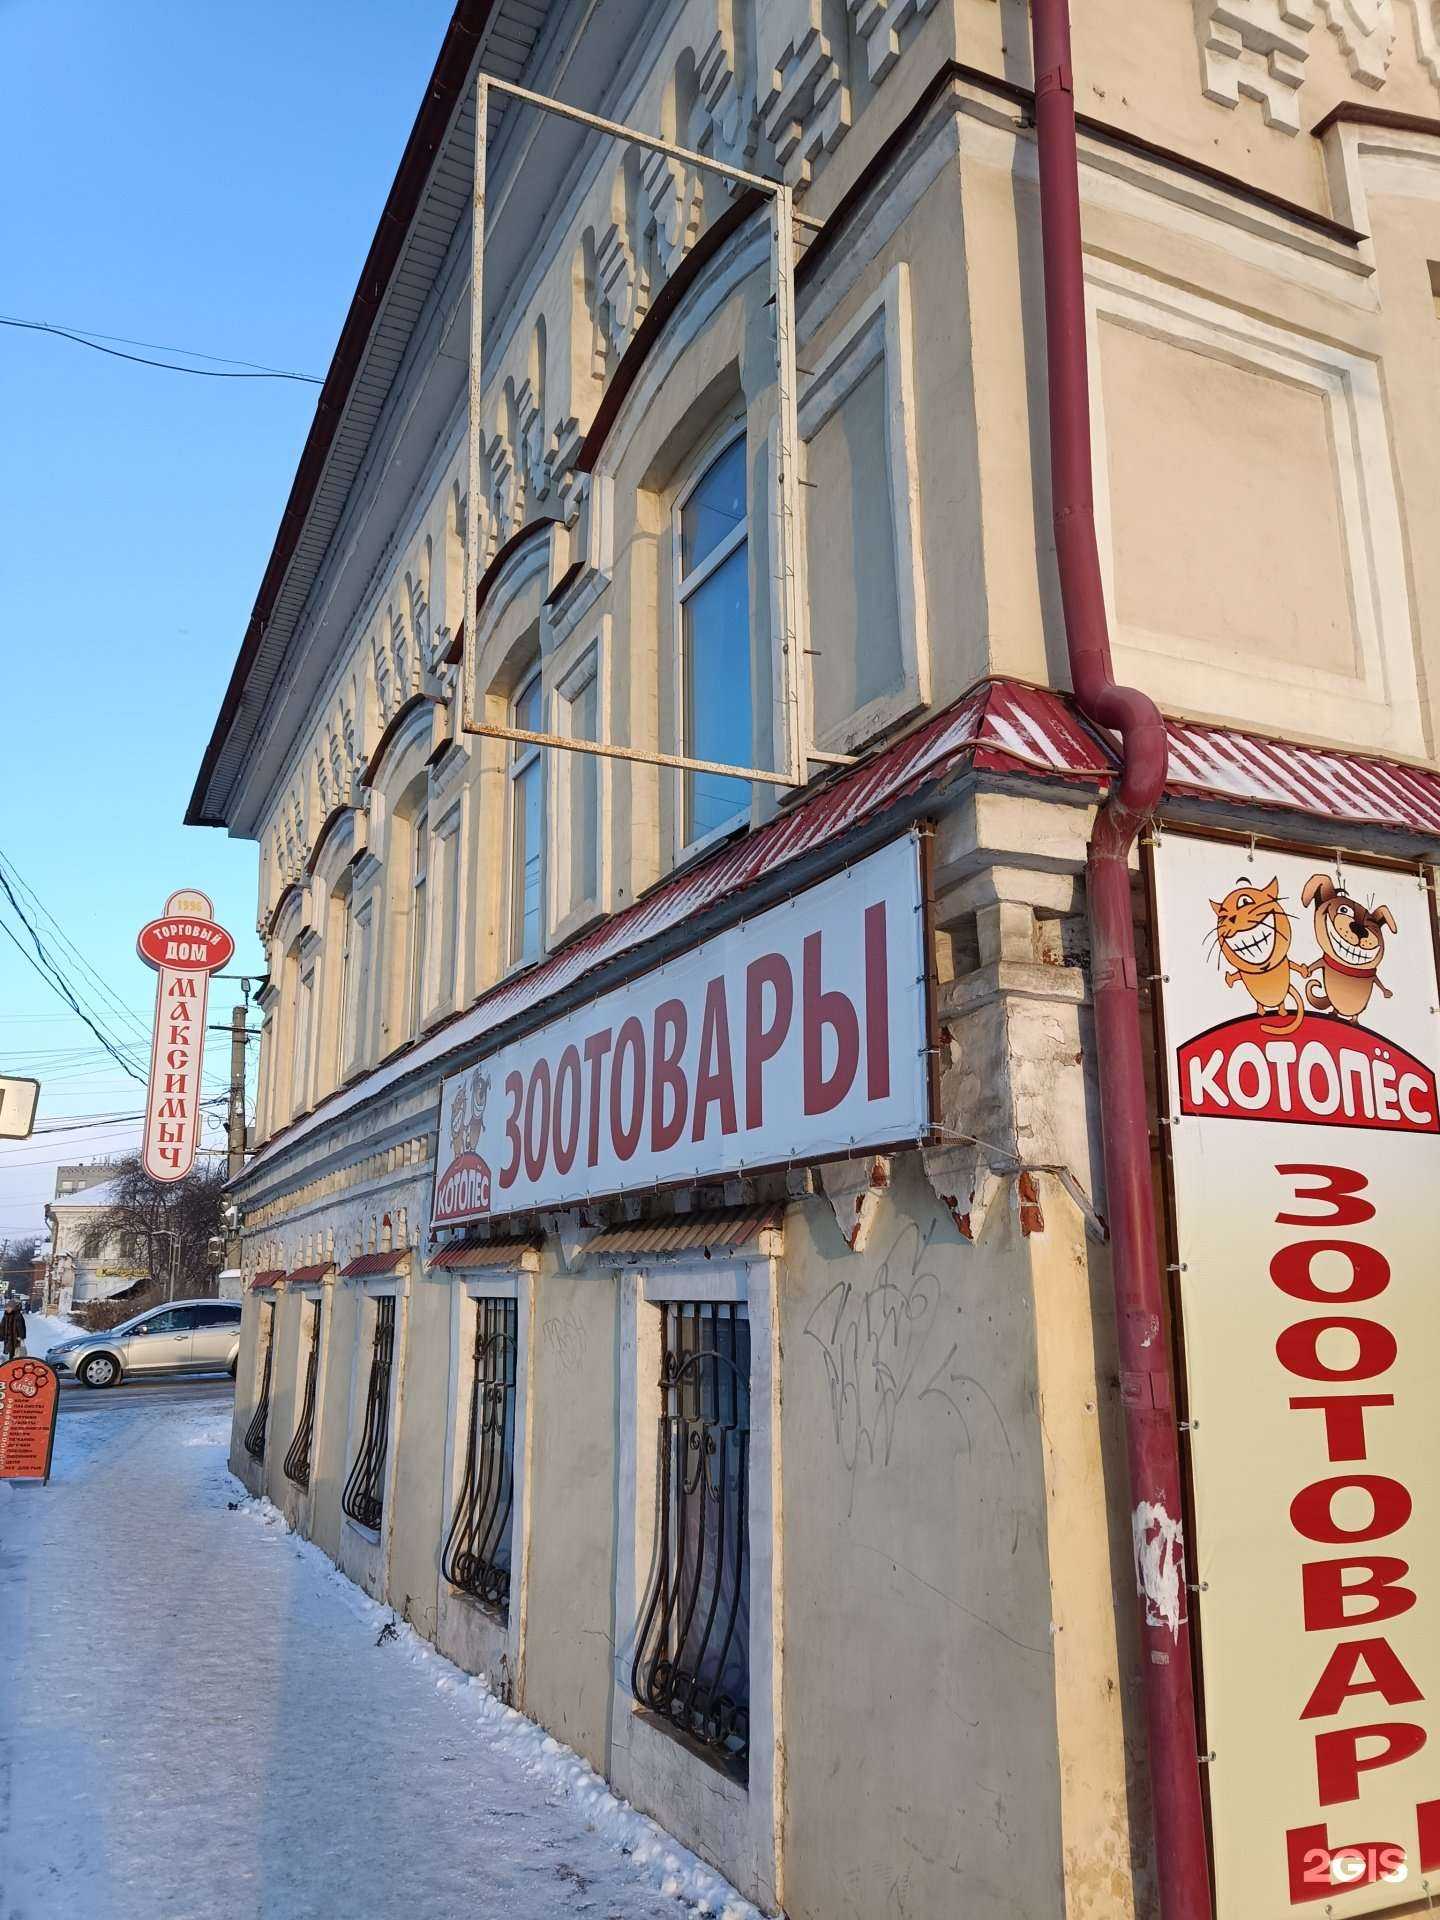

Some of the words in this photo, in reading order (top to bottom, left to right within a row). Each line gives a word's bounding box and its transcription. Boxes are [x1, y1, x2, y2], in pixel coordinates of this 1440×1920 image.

[152, 924, 223, 946] ТОРГОВЫЙ
[165, 941, 208, 962] ДОМ
[158, 977, 198, 1169] МАКСИМЫЧ
[498, 900, 891, 1190] ЗООТОВАРЫ
[1189, 1042, 1432, 1124] КОТОПЁС
[1269, 1163, 1440, 1904] ЗООТОВАРЫ
